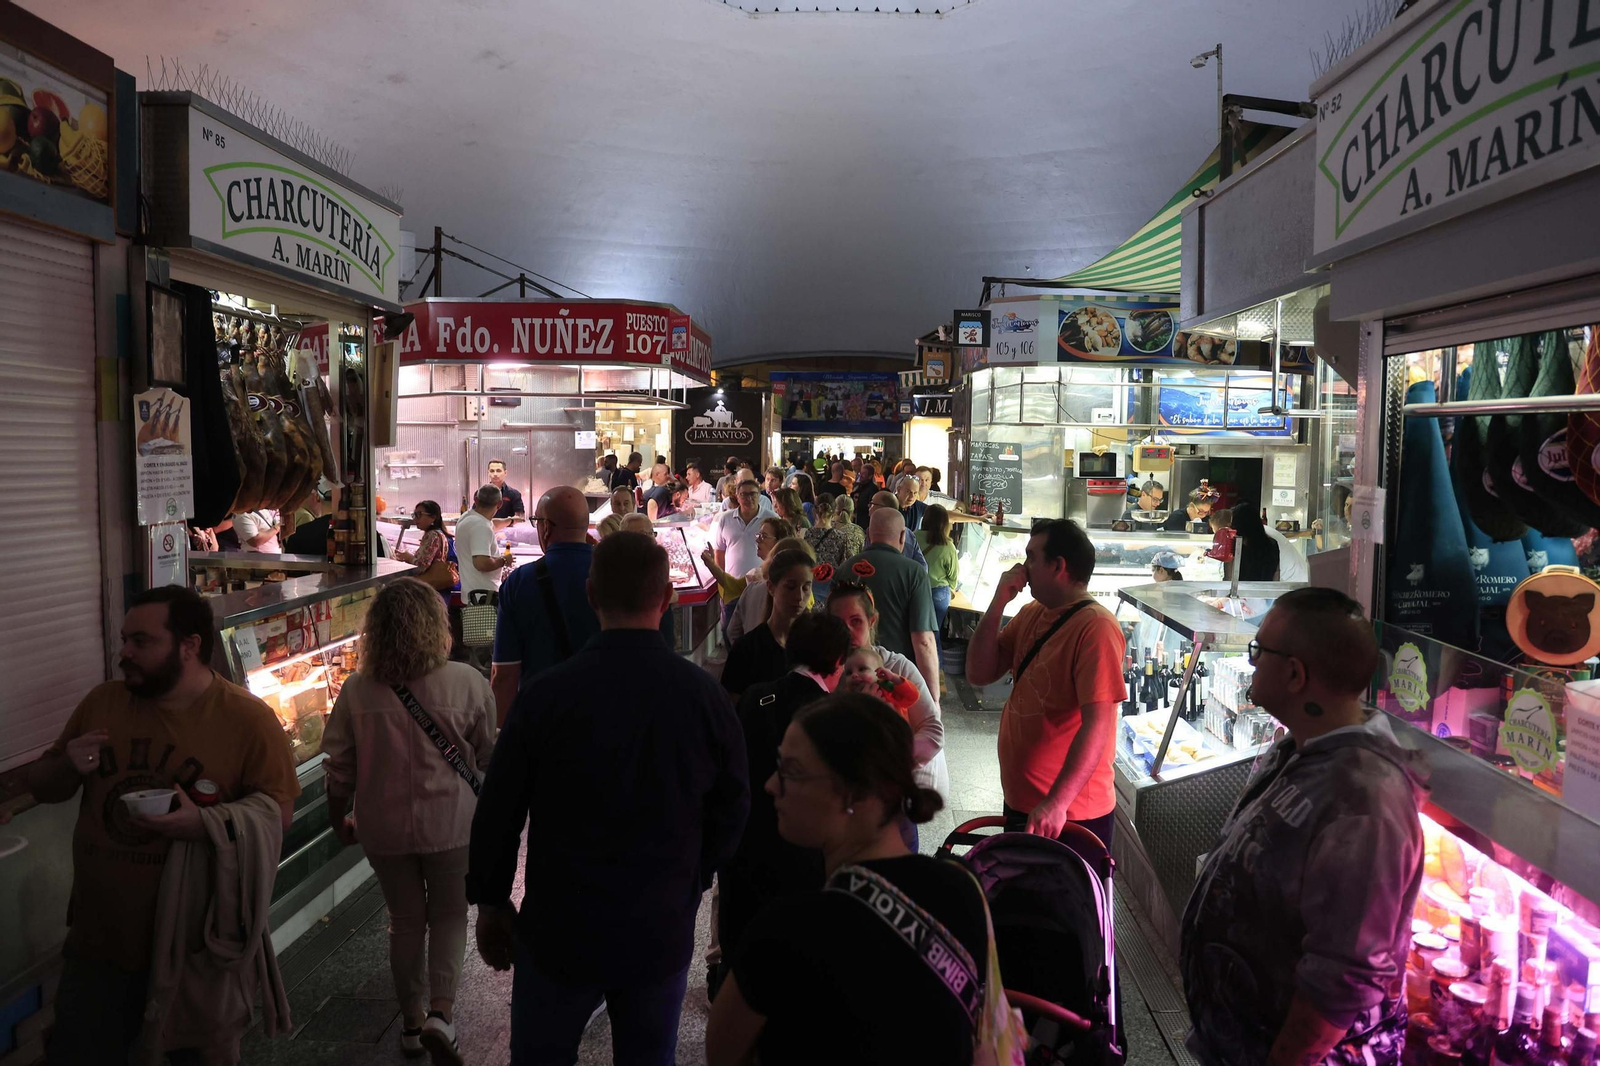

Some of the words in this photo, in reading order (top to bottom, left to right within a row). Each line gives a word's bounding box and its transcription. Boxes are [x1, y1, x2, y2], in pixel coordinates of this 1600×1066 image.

[1331, 93, 1342, 115] 52
[214, 136, 226, 148] 85
[1400, 167, 1432, 216] A.
[227, 177, 380, 280] CHARCUTERÍA
[272, 236, 290, 264] A.
[296, 250, 352, 284] MARÍN
[436, 316, 500, 354] Fdo.
[511, 308, 615, 354] NUÑEZ
[626, 312, 667, 334] PUESTO
[626, 334, 666, 356] 107
[996, 342, 1010, 355] 105
[1011, 347, 1016, 360] y
[1020, 341, 1034, 354] 106
[921, 399, 952, 416] J.M.
[694, 430, 710, 440] J.M.
[712, 430, 746, 439] SANTOS
[405, 698, 430, 729] BIMBA
[1509, 718, 1551, 742] CHARCUTERÍA
[1506, 732, 1552, 761] MARÍN
[848, 874, 906, 926] LOLA
[902, 919, 919, 944] Y
